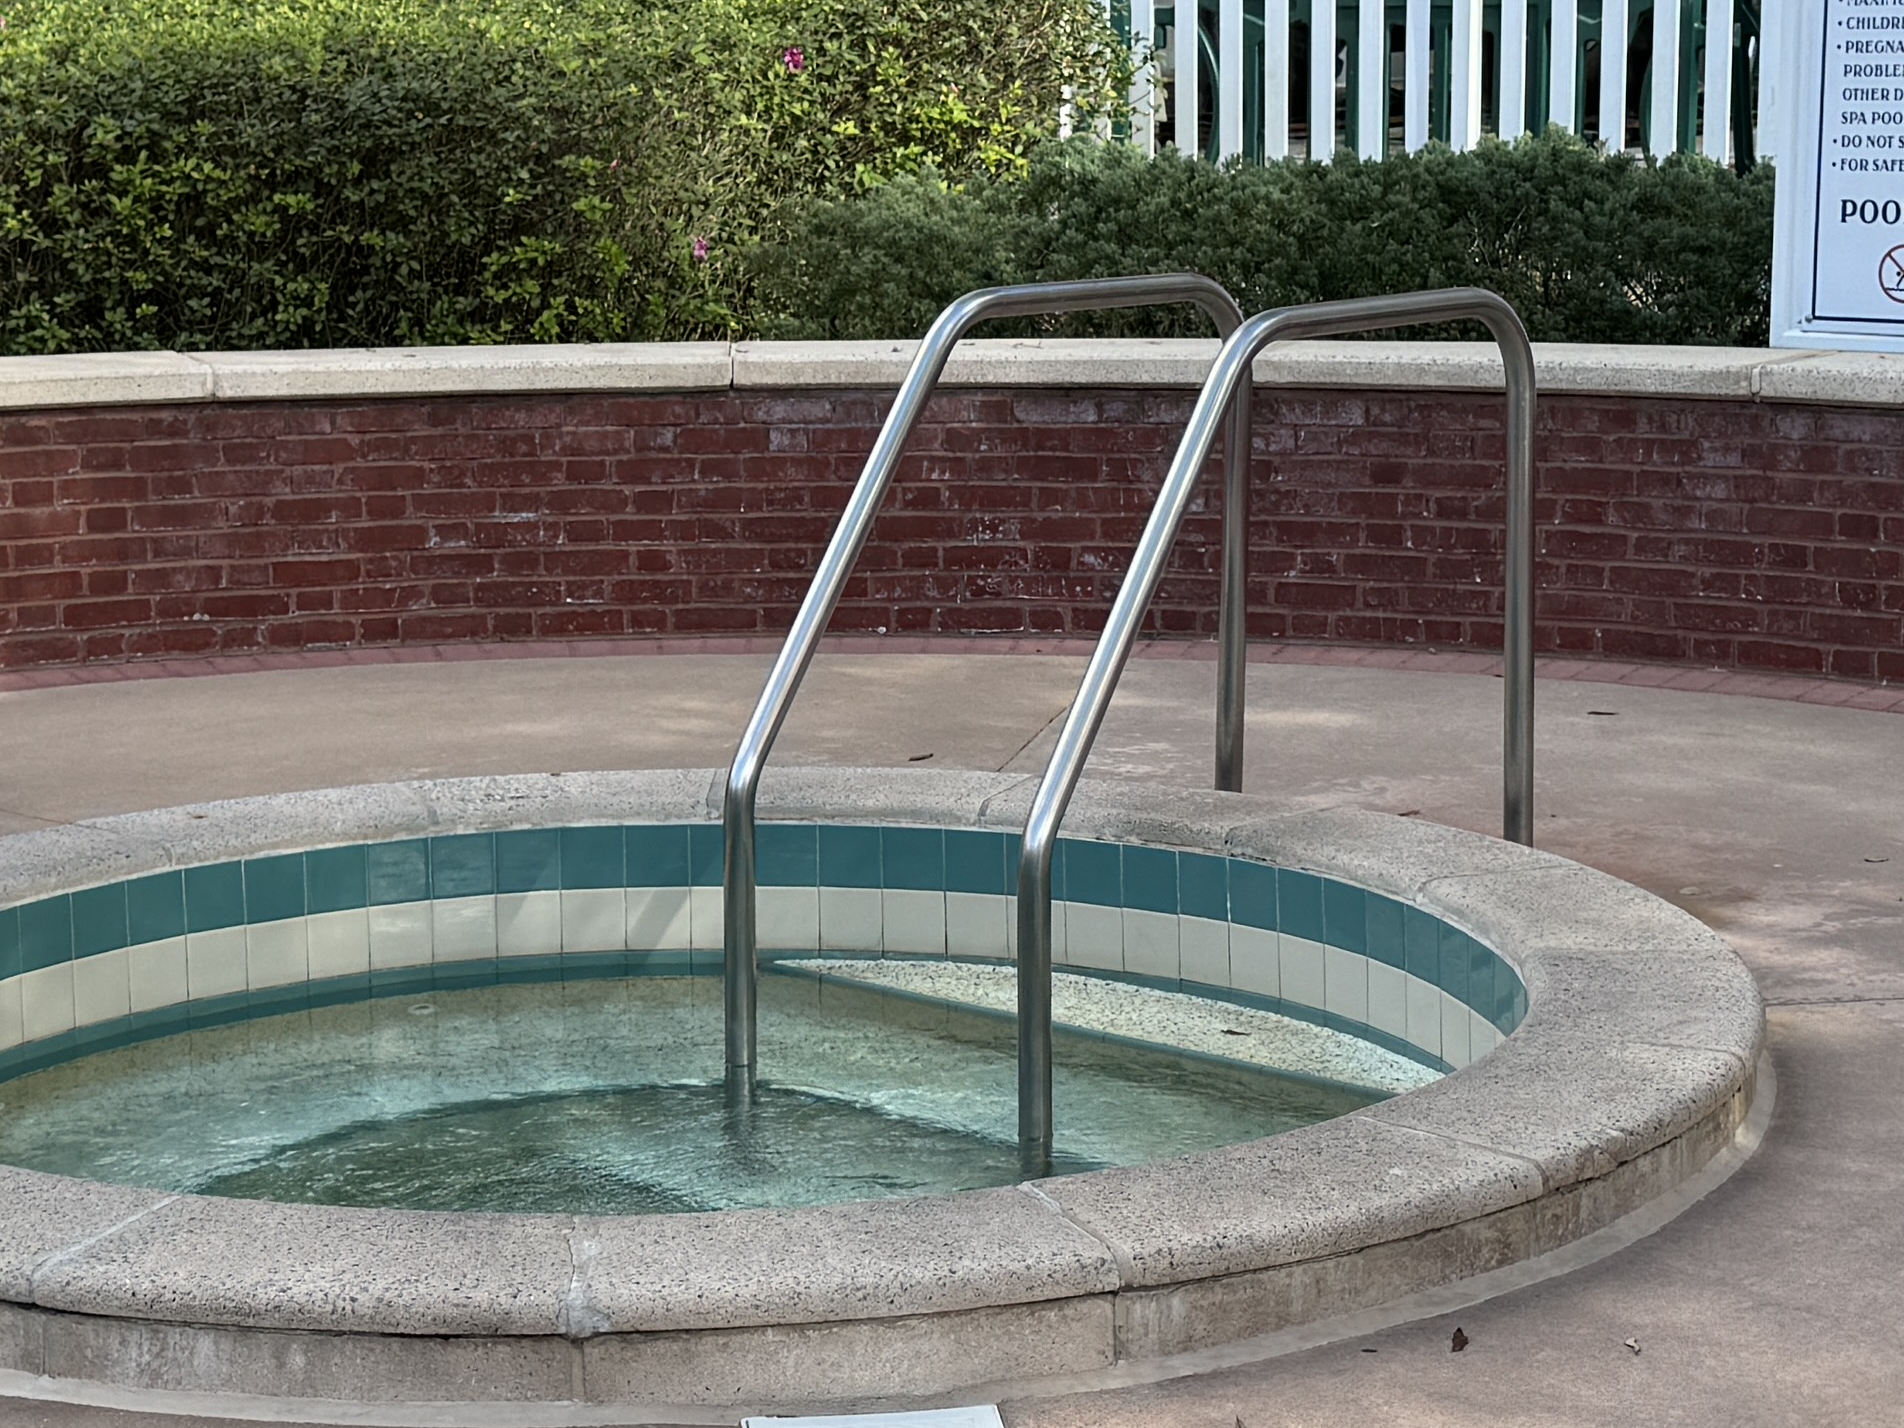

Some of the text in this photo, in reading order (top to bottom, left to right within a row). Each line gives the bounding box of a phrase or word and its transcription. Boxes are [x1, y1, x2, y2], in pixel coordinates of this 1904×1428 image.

[1842, 87, 1890, 102] OTHER
[1840, 110, 1868, 125] SPA
[1841, 134, 1863, 149] DO
[1865, 134, 1896, 149] NOT
[1840, 157, 1869, 172] FOR
